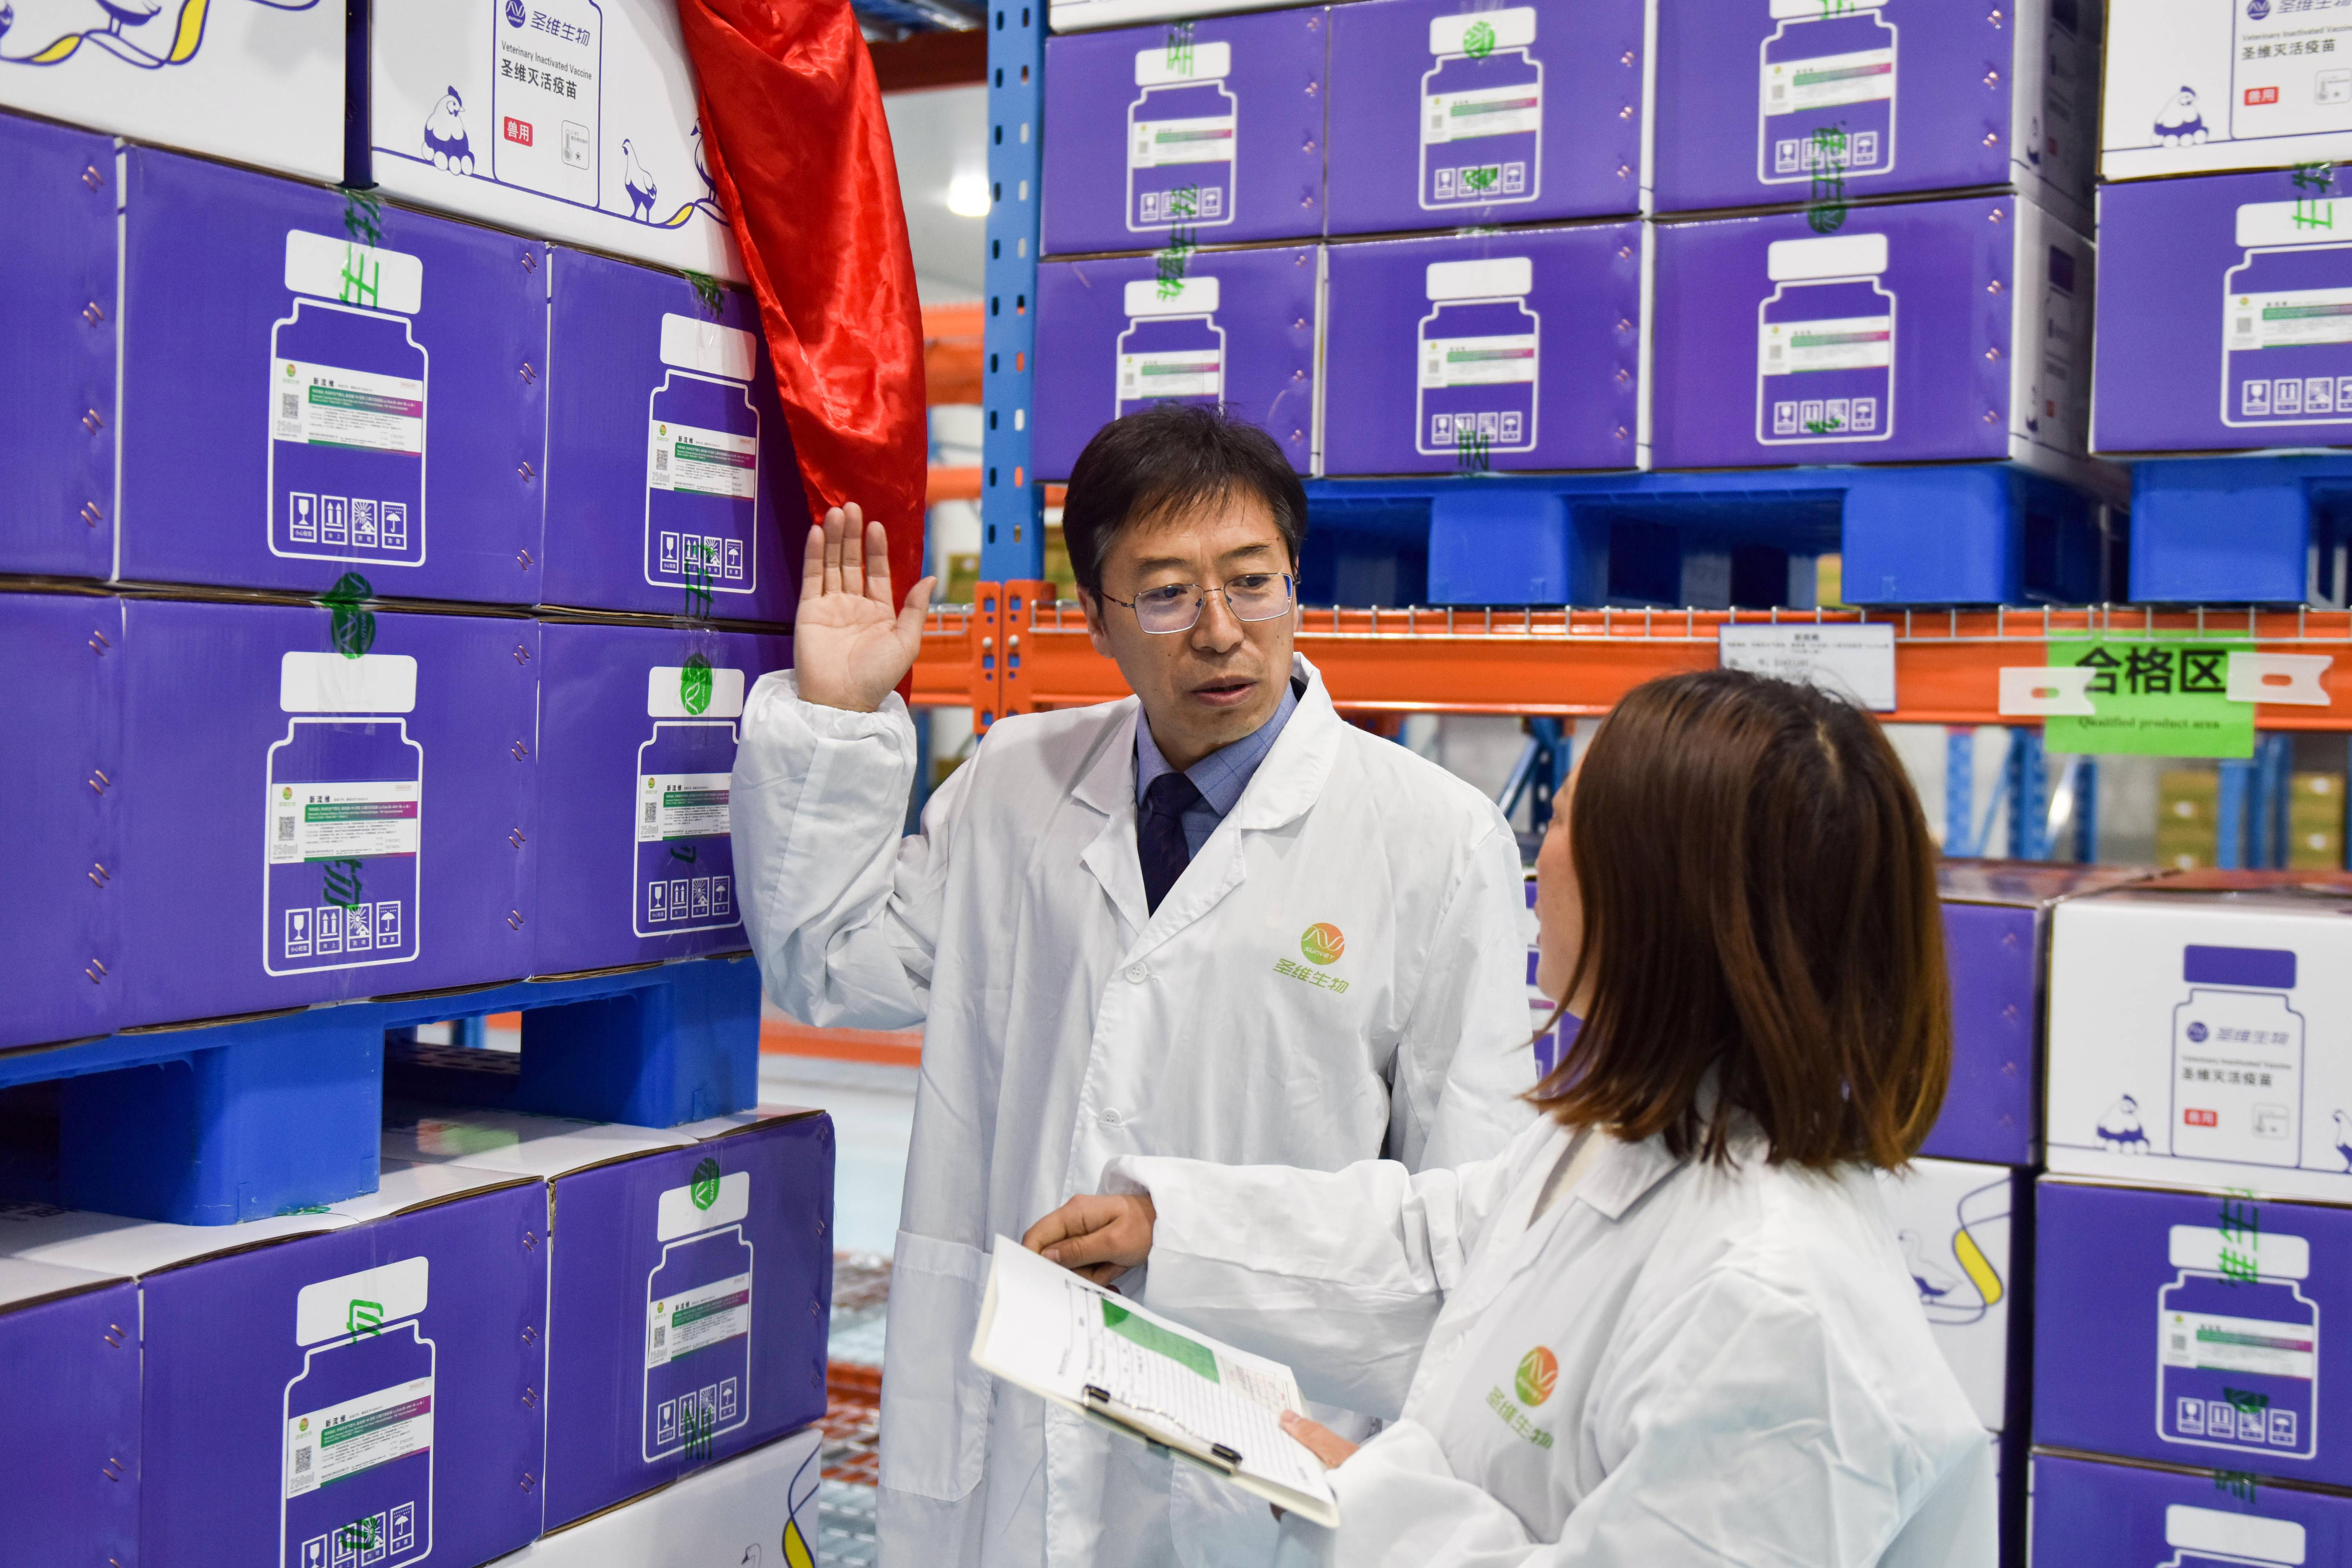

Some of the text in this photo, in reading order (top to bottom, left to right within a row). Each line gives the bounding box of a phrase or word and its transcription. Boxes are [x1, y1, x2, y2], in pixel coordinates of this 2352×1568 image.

[530, 11, 590, 46] 圣维生物
[502, 40, 592, 80] Veterinary Inactivated Vaccine
[501, 58, 577, 100] 圣维灭活疫苗
[507, 120, 529, 142] 兽用
[652, 471, 670, 483] 250ml
[2075, 647, 2226, 694] 合格区
[641, 825, 658, 834] 250ml
[273, 844, 298, 855] 250ml
[1304, 946, 1335, 960] SUNVET
[1273, 958, 1349, 994] 圣维生物
[290, 1472, 315, 1490] 250ml
